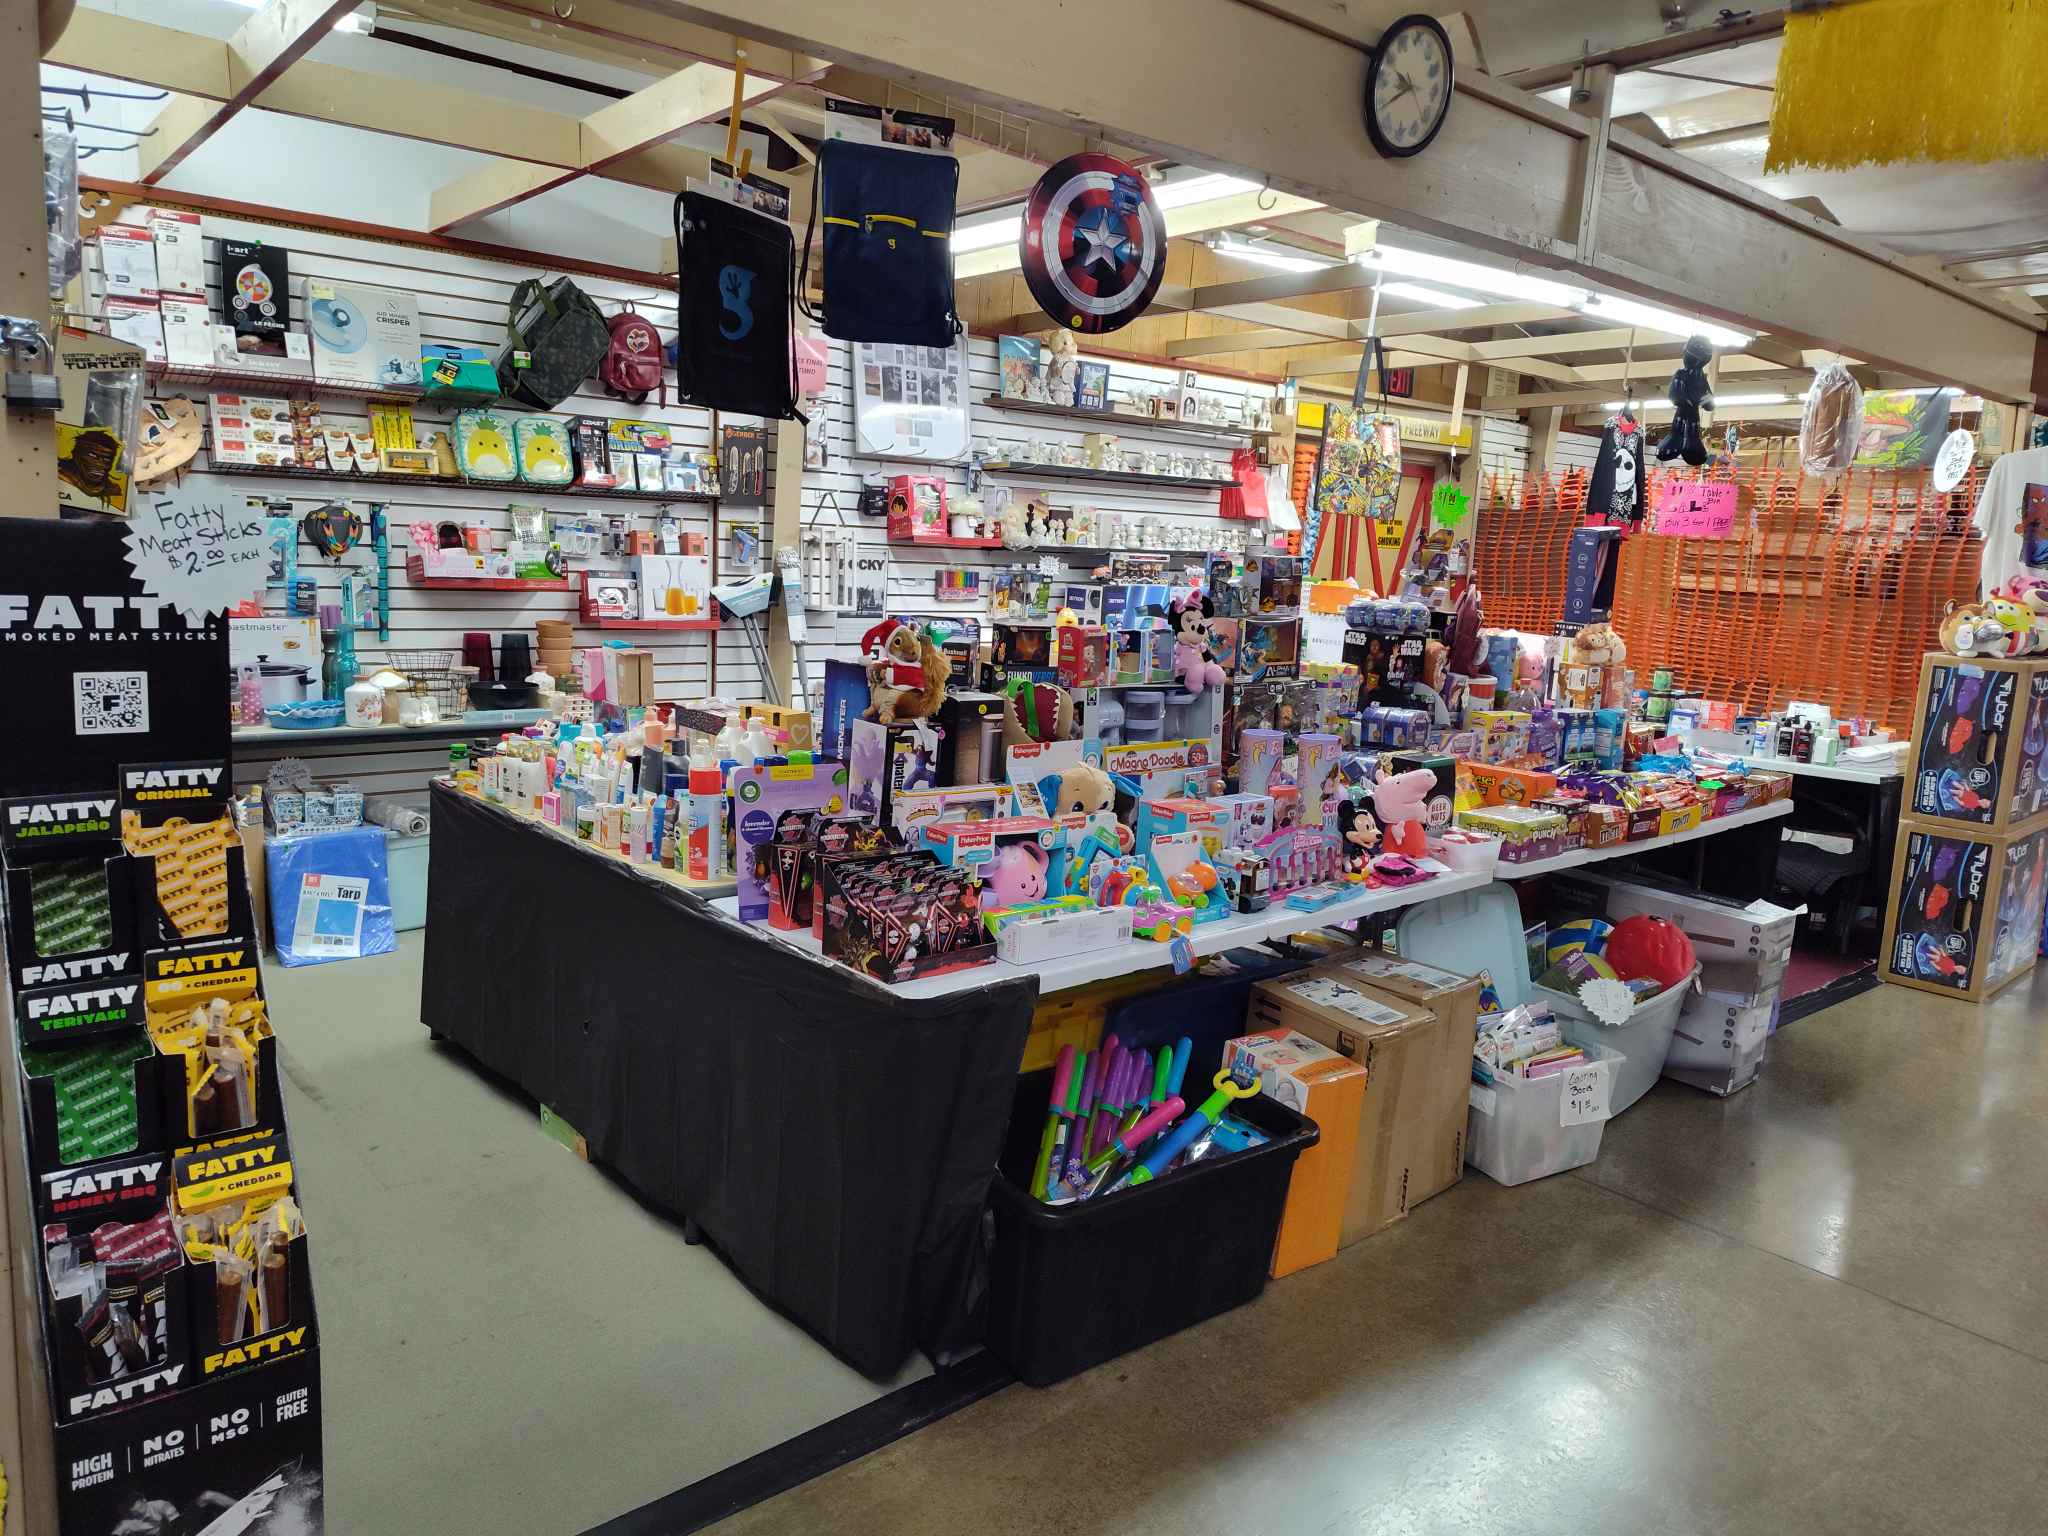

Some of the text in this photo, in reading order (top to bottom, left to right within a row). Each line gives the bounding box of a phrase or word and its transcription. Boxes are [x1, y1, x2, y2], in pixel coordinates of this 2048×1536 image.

[376, 316, 410, 326] CRISPER
[1700, 485, 1722, 497] Table
[155, 500, 228, 530] Fatty
[139, 520, 263, 557] Meat Sticks
[1377, 536, 1401, 546] SMOKING
[1386, 526, 1394, 536] NO
[231, 549, 260, 565] EACH
[5, 632, 218, 642] MOKED MEAT STICKS
[1345, 631, 1367, 640] STAR
[1345, 638, 1367, 646] WARS
[1401, 640, 1424, 649] STAR
[1401, 647, 1424, 656] WARS
[1992, 677, 2013, 731] flybar
[837, 698, 847, 760] MONSTER
[1111, 752, 1186, 773] Magna Doodle
[126, 767, 223, 788] FATTY
[136, 788, 212, 801] ORIGINAL
[9, 800, 117, 824] FATTY
[1430, 812, 1447, 822] NUTS
[1431, 803, 1447, 812] BEER
[16, 819, 110, 838] JALAPEÑO
[1531, 828, 1557, 841] PUNCH
[959, 835, 991, 846] Fisher-Price
[1969, 846, 1989, 900] flybar
[336, 886, 361, 900] Tarp
[22, 953, 129, 985] FATTY
[158, 951, 245, 976] FATTY
[194, 975, 248, 988] CHEDDAR
[28, 985, 138, 1019] FATTY
[40, 1009, 126, 1031] TERIYAKI
[189, 1146, 276, 1181] FATTY
[51, 1162, 163, 1200] FATTY
[228, 1171, 282, 1190] CHEDDAR
[54, 1184, 157, 1212] HONEY BBQ
[204, 1326, 307, 1373] FATTY
[70, 1363, 184, 1416] FATTY
[276, 1387, 308, 1406] GLUTEN
[210, 1408, 250, 1432] NO
[276, 1398, 308, 1422] FREE
[143, 1430, 185, 1454] NO
[211, 1425, 249, 1445] MSG
[72, 1452, 112, 1479] HIGH
[143, 1447, 185, 1468] NITRATES
[71, 1470, 114, 1491] PROTEIN
